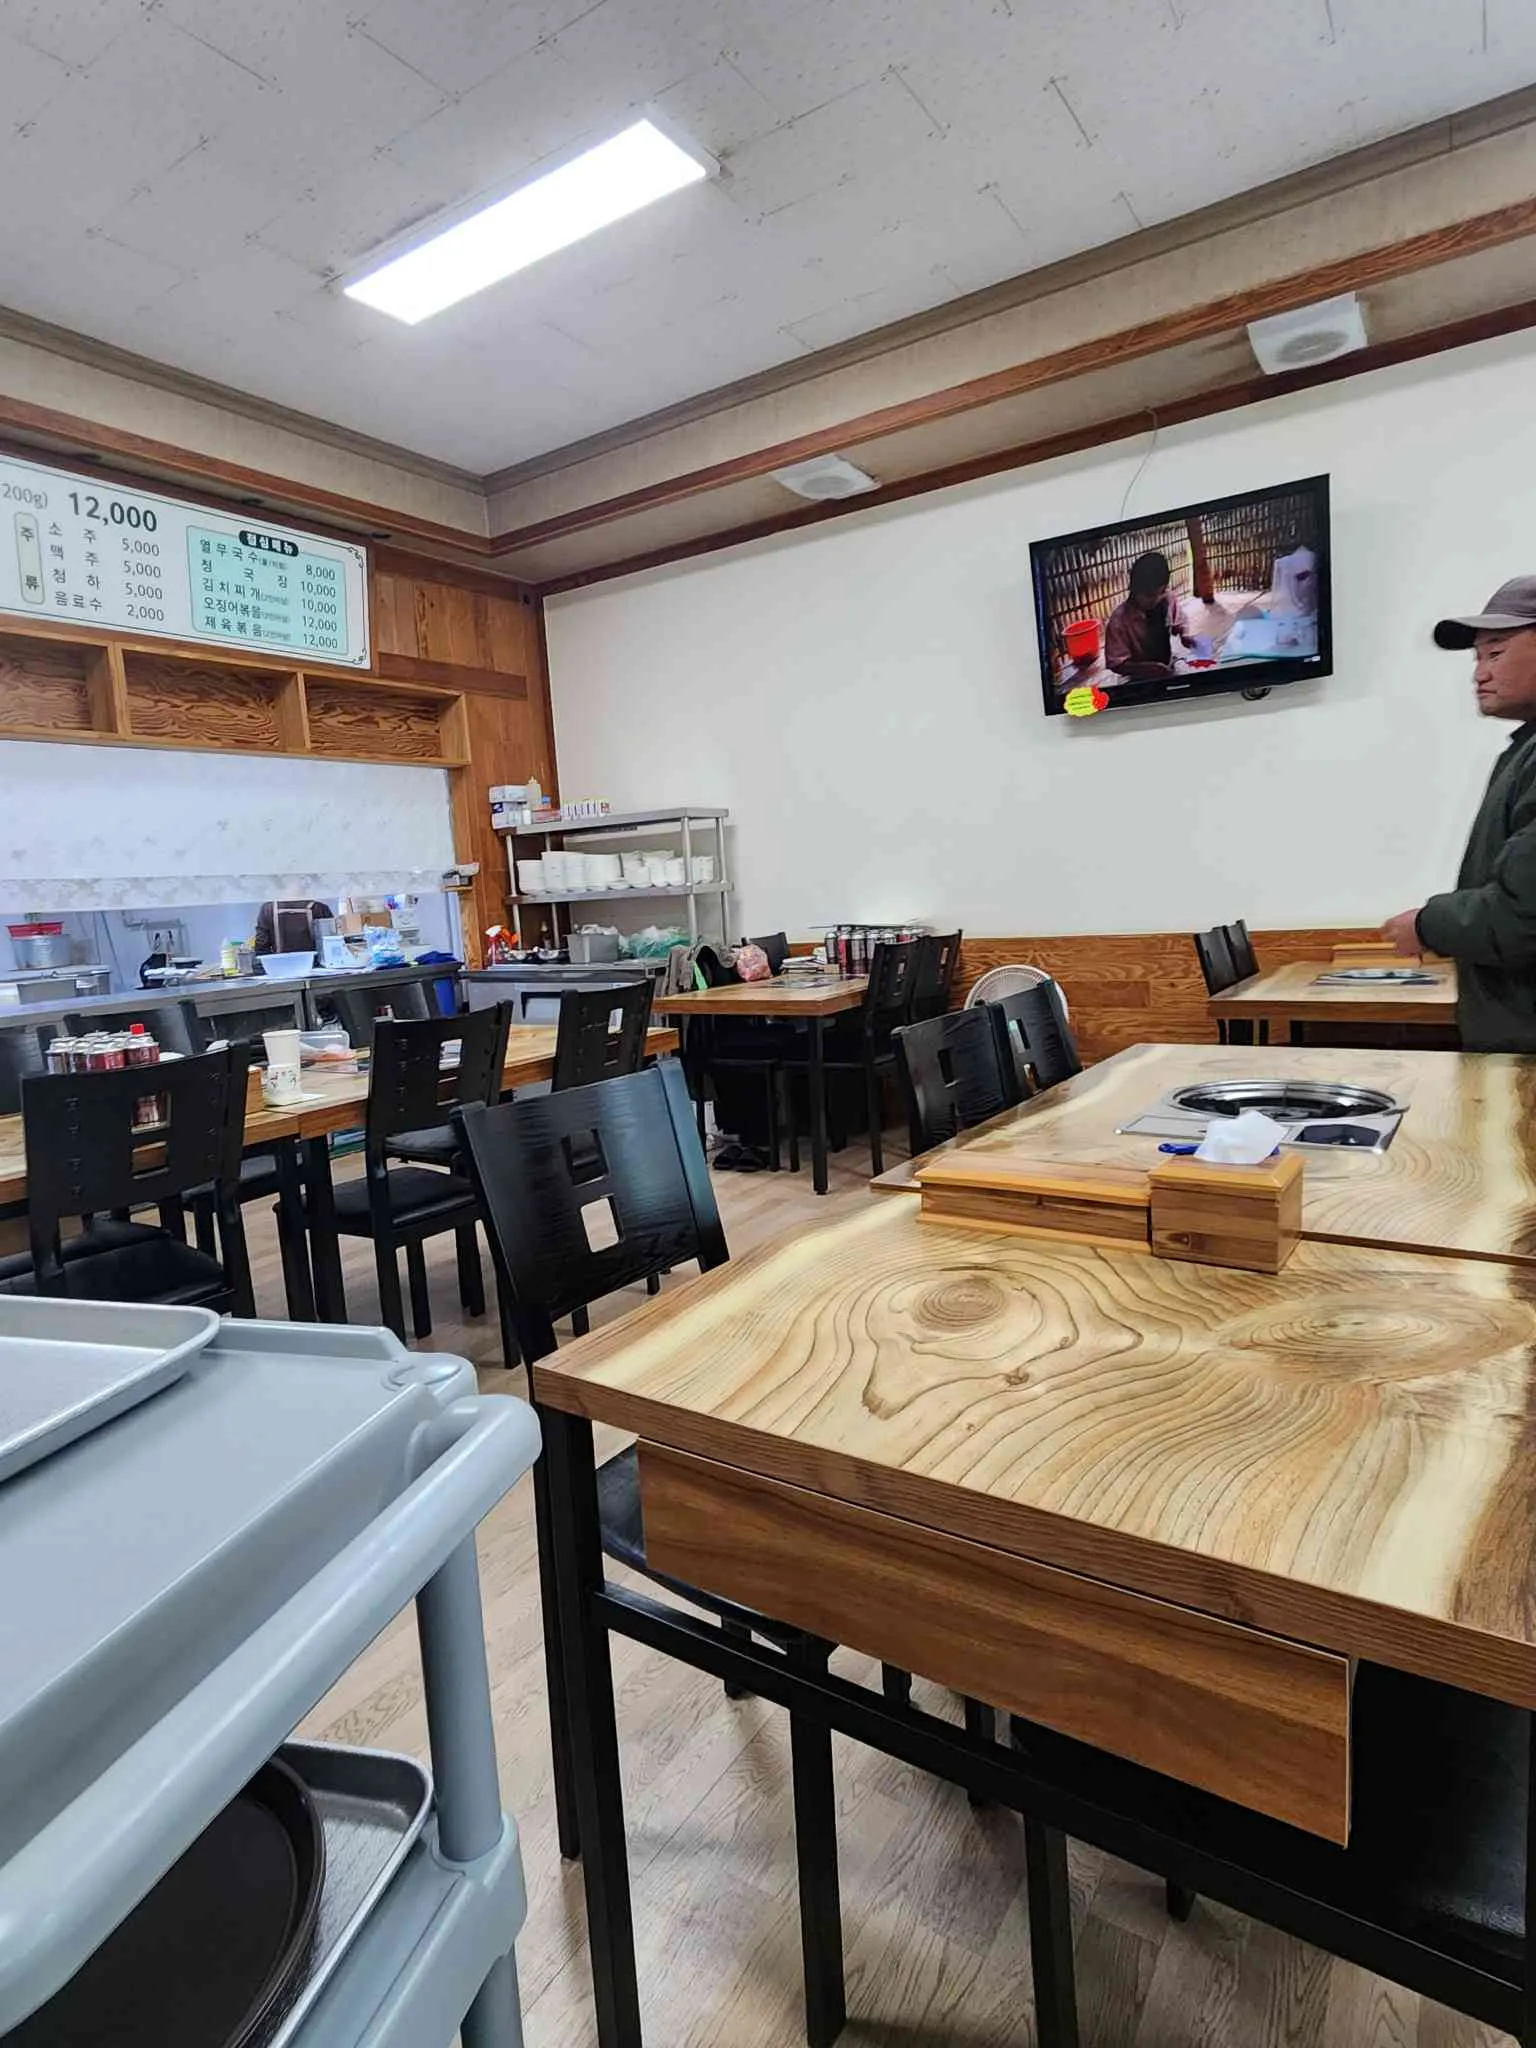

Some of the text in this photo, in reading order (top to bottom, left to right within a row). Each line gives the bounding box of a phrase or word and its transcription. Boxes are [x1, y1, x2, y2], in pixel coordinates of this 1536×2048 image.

[1, 483, 157, 532] 200g) 12,000
[122, 537, 160, 556] 5,000
[123, 560, 161, 578] 5,000
[305, 564, 335, 580] 8,000
[125, 582, 163, 600] 5,000
[202, 577, 261, 601] 김치찌개
[302, 598, 337, 616] 10,000
[301, 581, 336, 598] 10,000
[54, 590, 164, 621] 음료수 2,000
[204, 596, 261, 619] 오징어볶음
[303, 615, 338, 632] 12,000
[304, 633, 338, 649] 12,000
